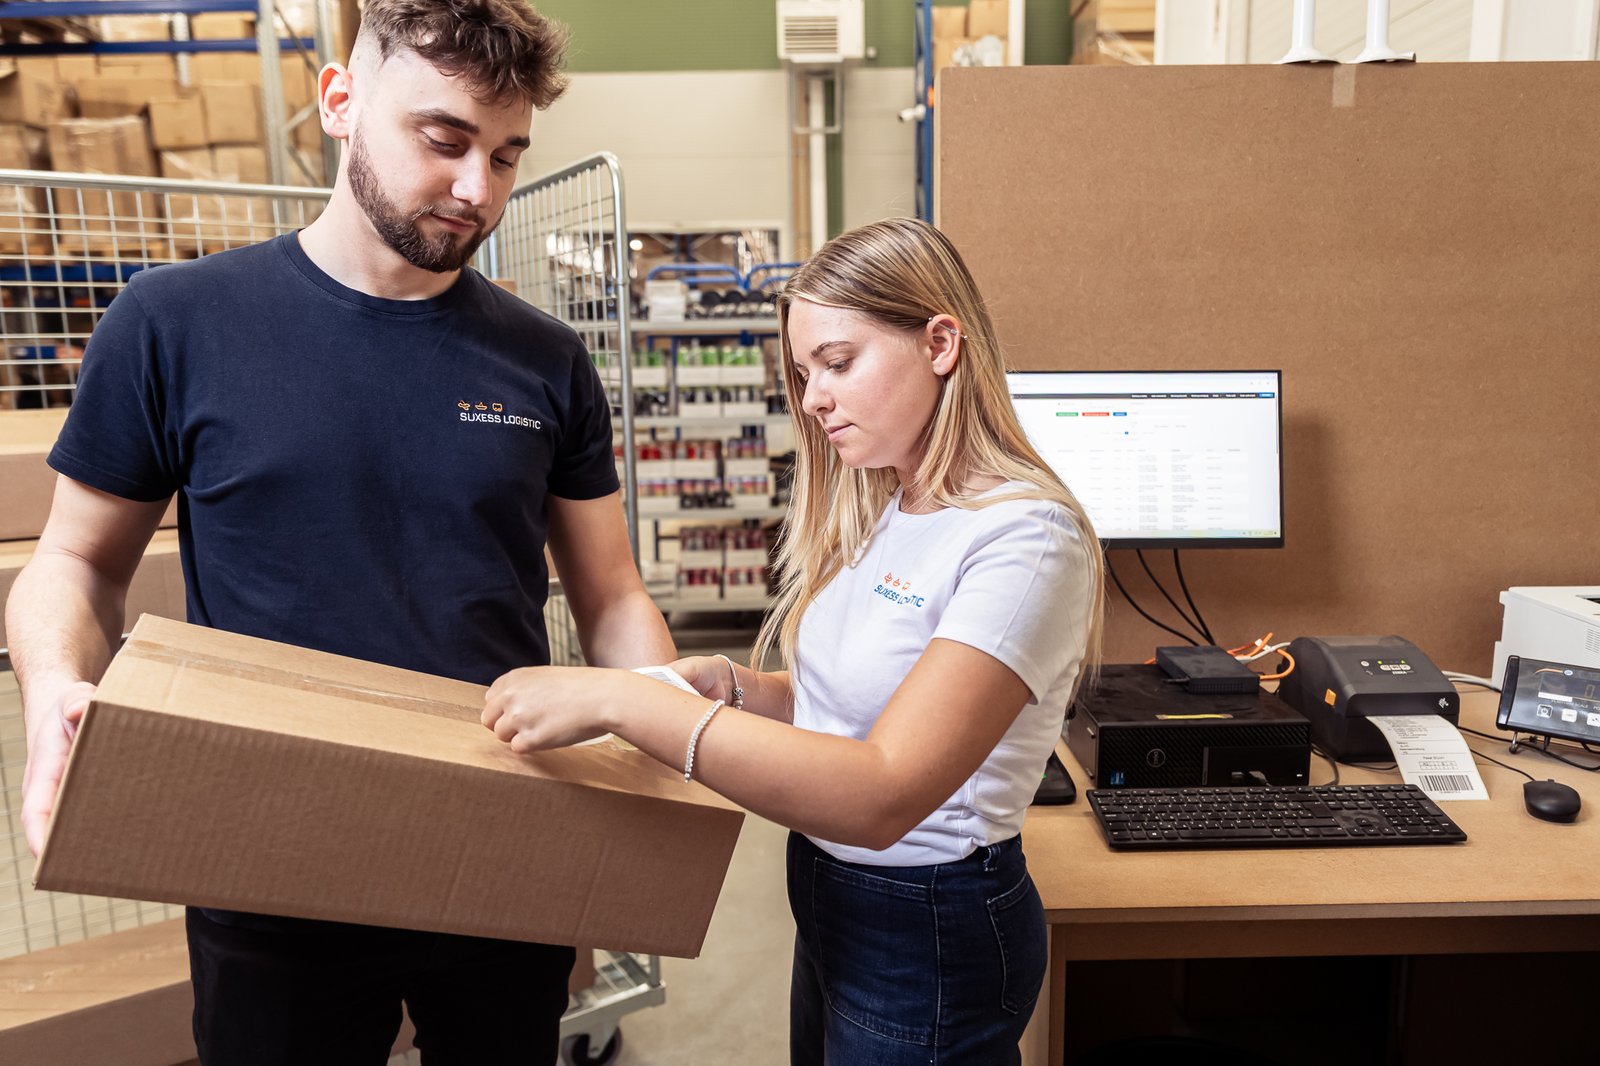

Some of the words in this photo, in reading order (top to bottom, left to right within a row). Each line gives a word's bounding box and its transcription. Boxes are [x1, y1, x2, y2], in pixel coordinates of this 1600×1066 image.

[459, 412, 502, 424] SUXESS
[503, 415, 542, 430] LOGISTIC
[873, 584, 900, 602] SUXESS
